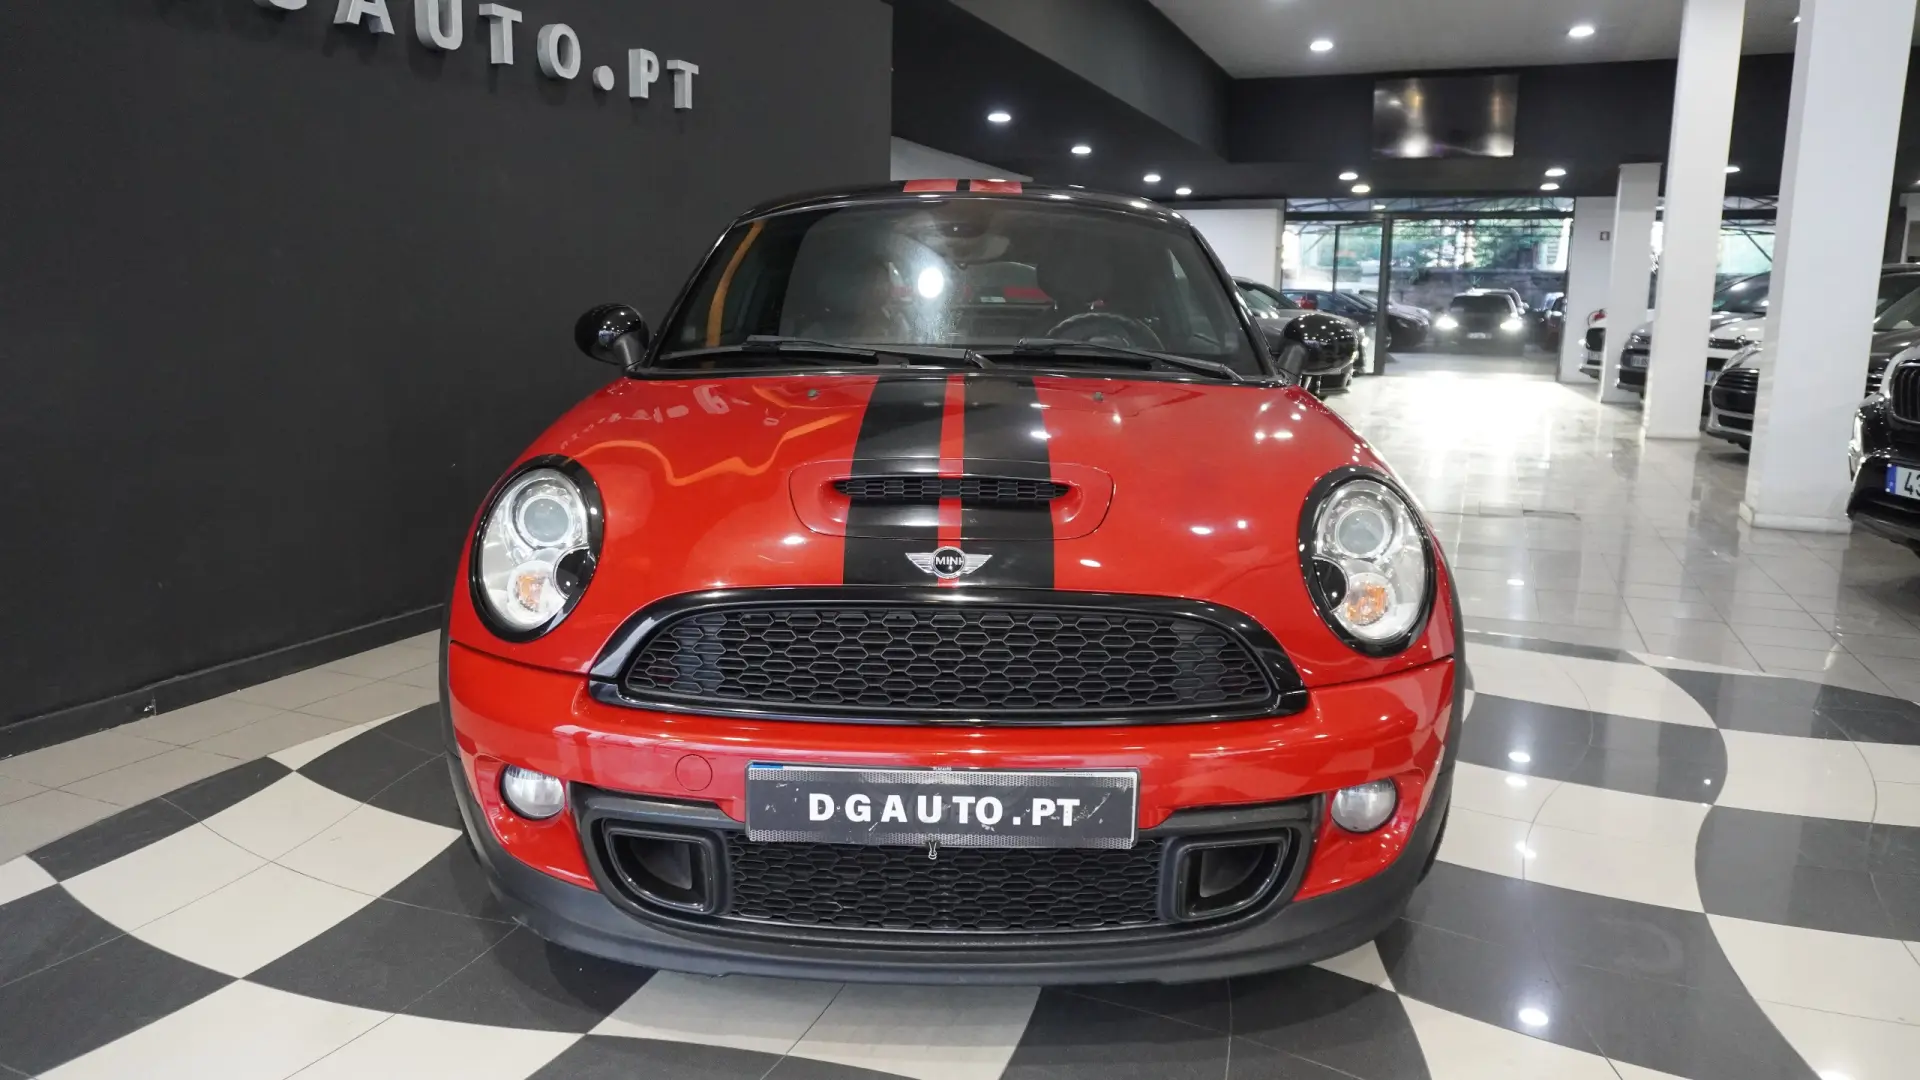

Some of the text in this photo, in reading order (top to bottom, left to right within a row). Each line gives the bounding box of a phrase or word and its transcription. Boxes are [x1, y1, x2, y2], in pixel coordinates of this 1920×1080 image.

[252, 0, 699, 109] AUTO.PT
[935, 556, 965, 566] MINI
[809, 793, 1080, 826] DGAUTO.PT
